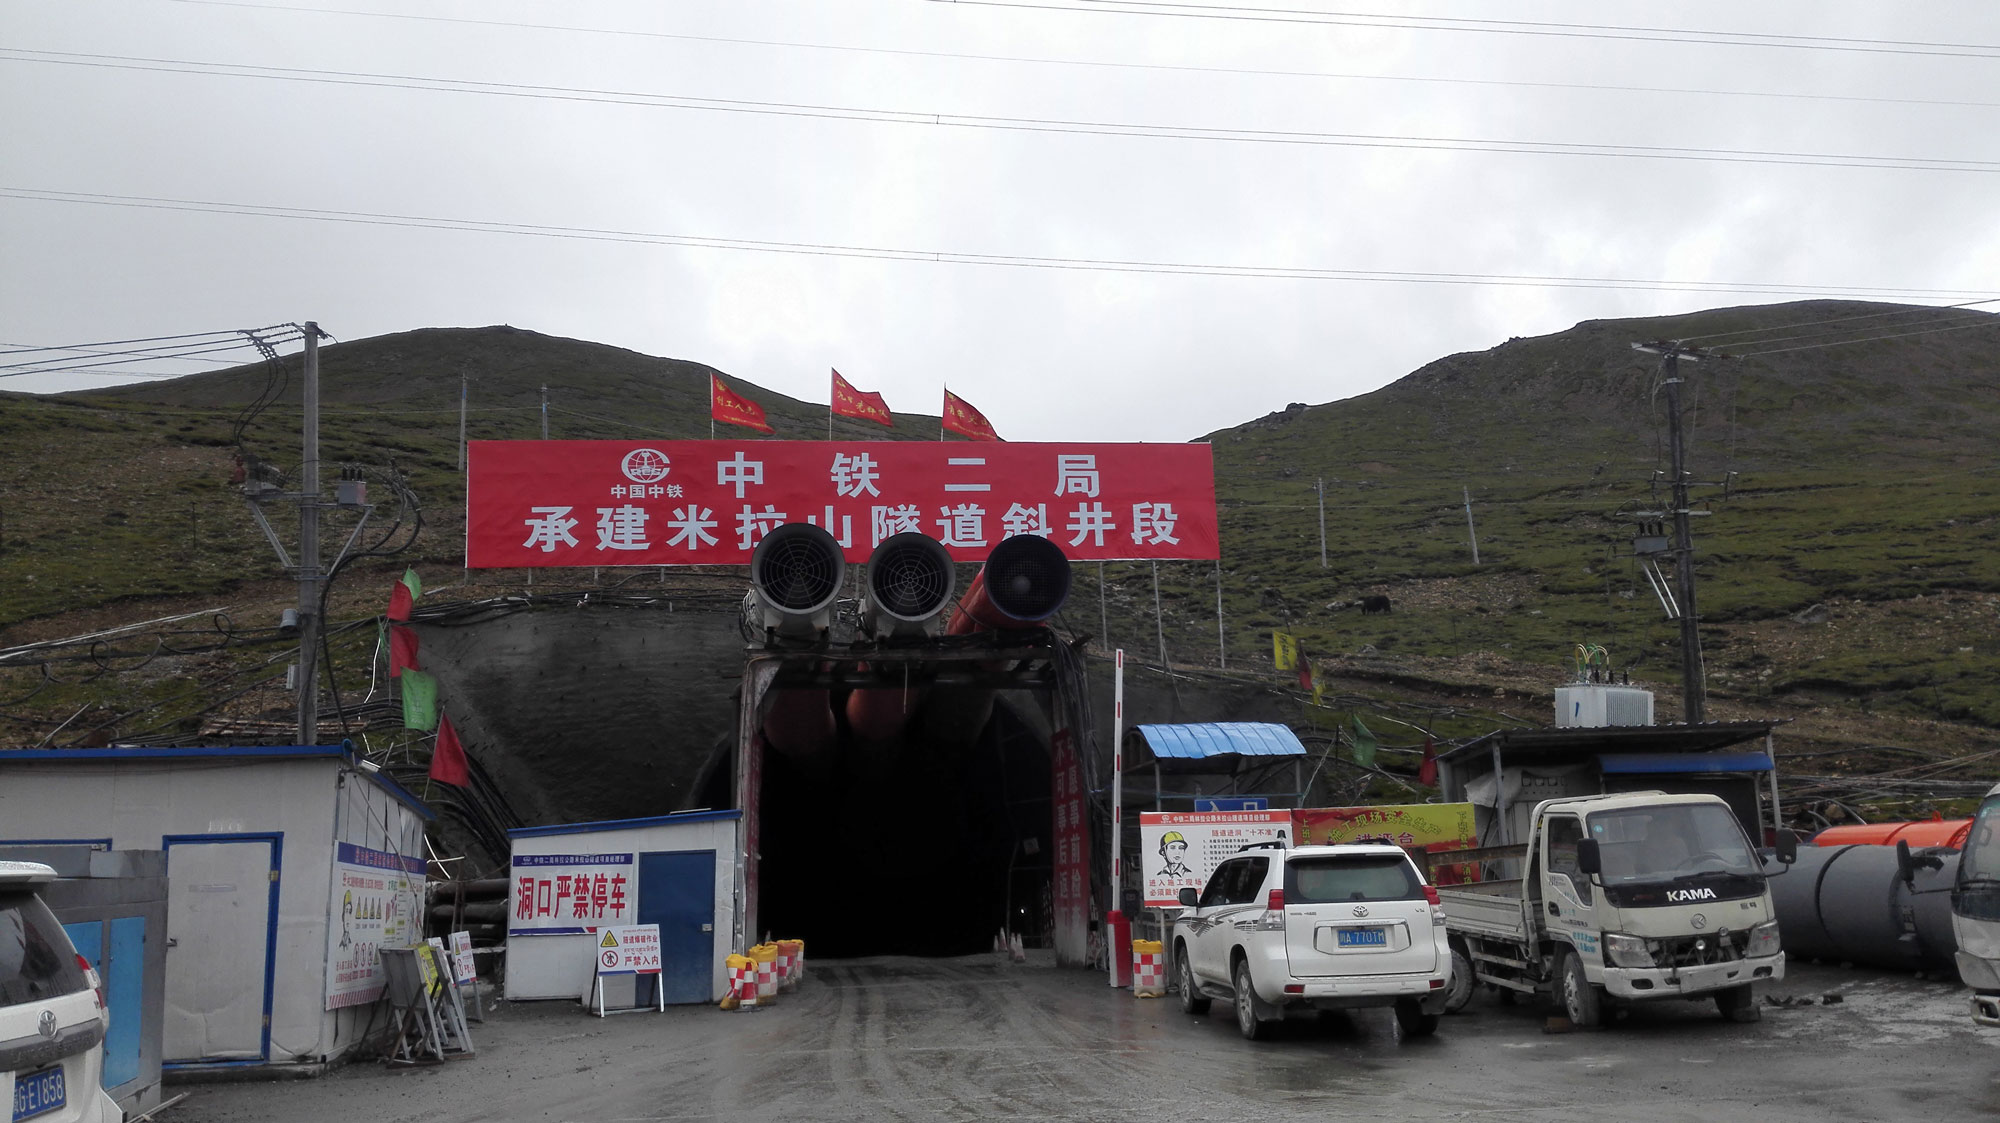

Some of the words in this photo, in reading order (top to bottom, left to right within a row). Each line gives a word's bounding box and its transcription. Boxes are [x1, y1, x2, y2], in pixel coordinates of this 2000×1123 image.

[717, 451, 1102, 499] 中铁二局
[610, 484, 683, 499] 中国中铁
[523, 502, 1181, 552] 承建米拉山隧道斜井段
[1329, 811, 1441, 842] 施工现场安全生产
[1149, 878, 1202, 887] 进入施工现场
[516, 872, 626, 920] 洞口严禁停车
[1150, 887, 1203, 897] 必须戴好帽
[1666, 888, 1717, 902] KAMA
[624, 955, 659, 967] 严禁入内
